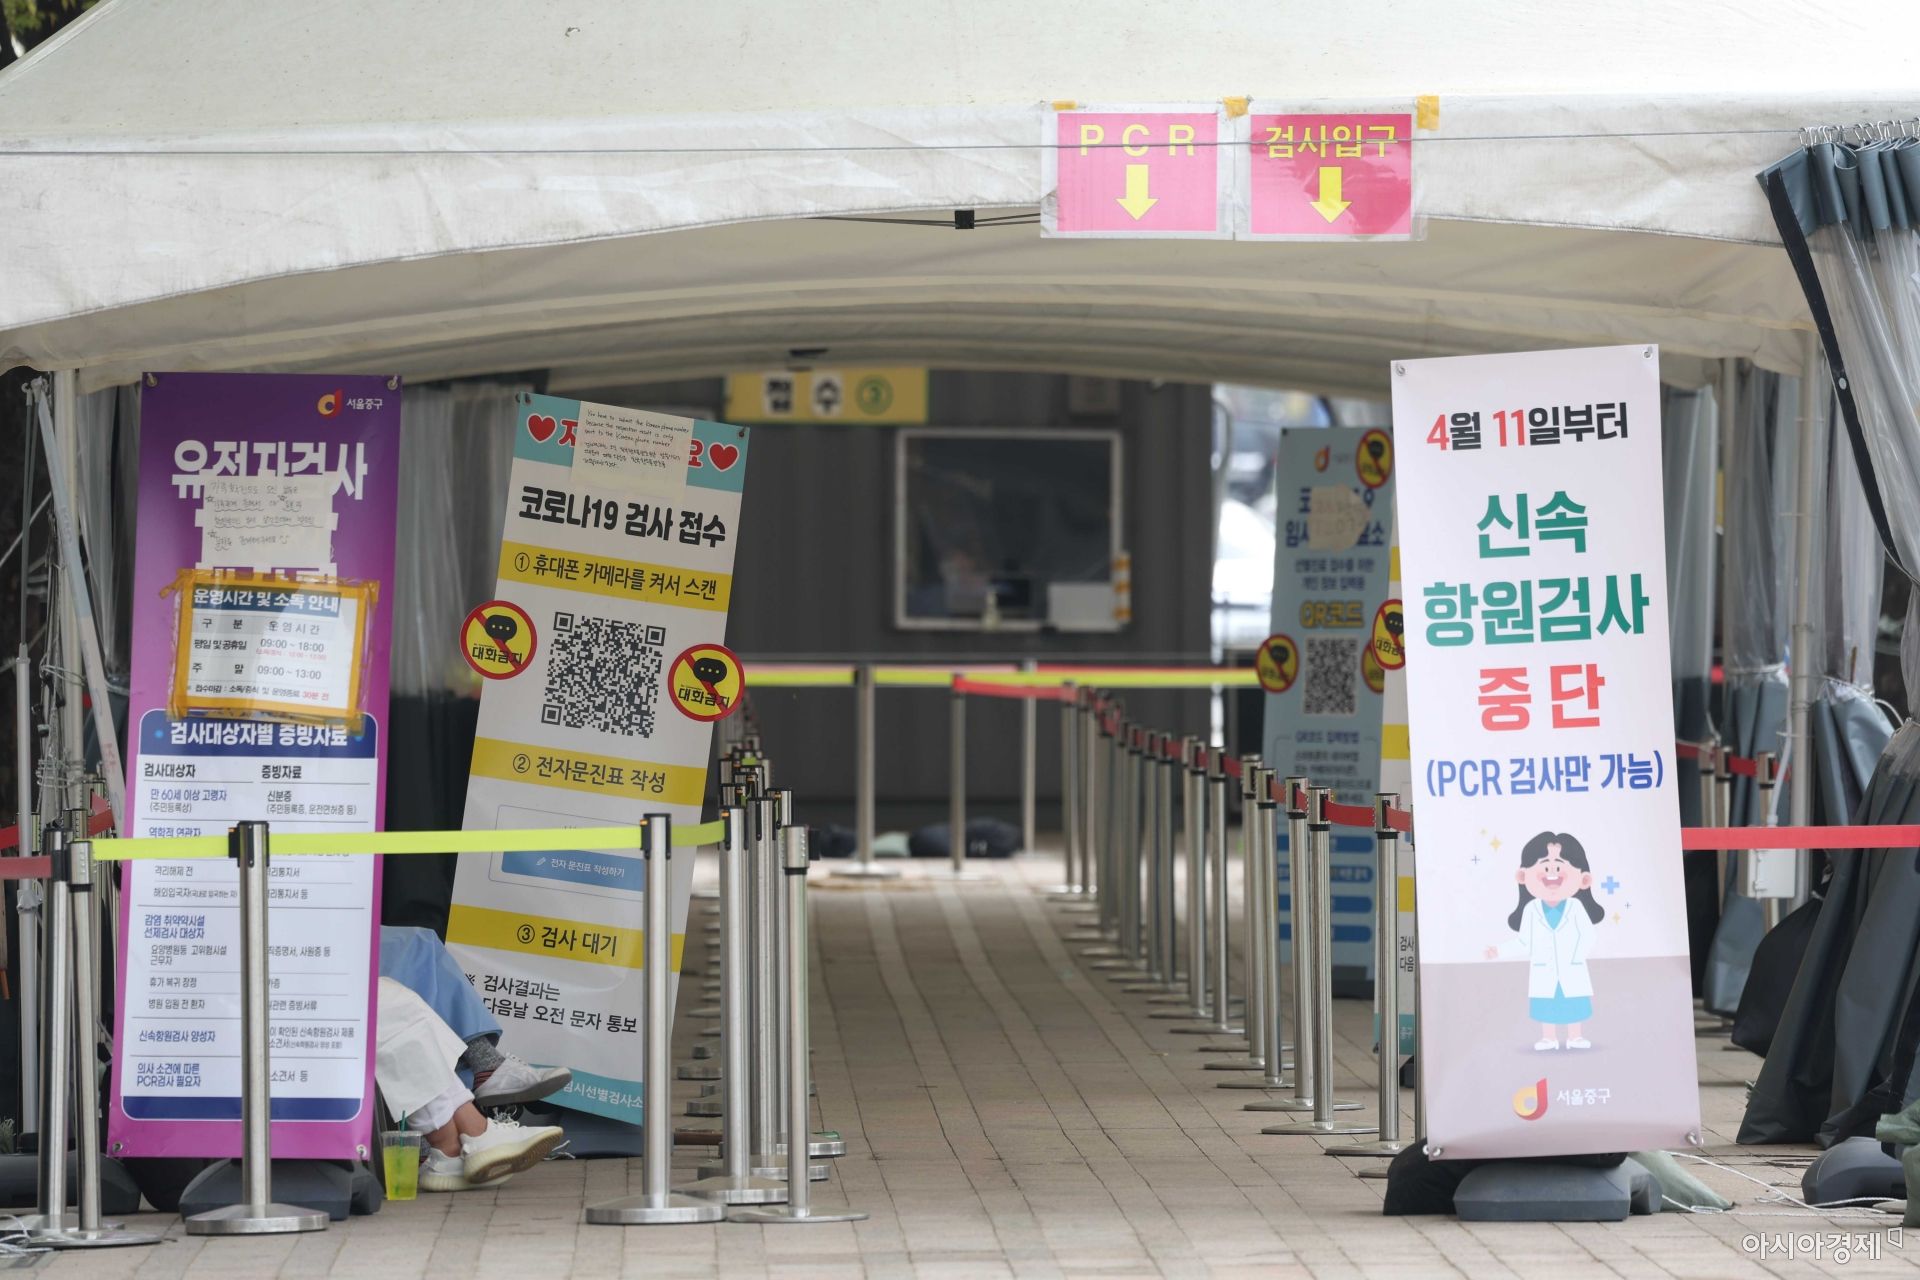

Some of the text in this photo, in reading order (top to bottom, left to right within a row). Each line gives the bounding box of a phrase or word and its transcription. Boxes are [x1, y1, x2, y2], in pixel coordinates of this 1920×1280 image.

[1079, 124, 1195, 157] PCR
[1264, 125, 1398, 159] 검사입구
[346, 398, 383, 410] 서울중구
[1426, 401, 1629, 451] 4월 11일부터
[518, 485, 726, 548] 코로나19 검사 접수
[1476, 490, 1589, 559] 신속
[533, 554, 580, 581] 휴대폰
[583, 562, 645, 591] 카메라를
[649, 572, 680, 597] 켜서
[683, 580, 717, 601] 스캔
[194, 588, 339, 613] 운영시간 및 소독 안내
[1423, 573, 1650, 647] 항원검사
[195, 640, 211, 649] 평일
[260, 638, 287, 648] 09:00
[299, 642, 324, 652] 18:00
[472, 646, 522, 665] 대화금지
[258, 665, 284, 676] 09:00
[295, 669, 321, 680] 13:00
[677, 687, 730, 709] 대화금지
[1478, 663, 1605, 732] 중단
[170, 722, 348, 746] 검사대상자별 증빙자료
[144, 763, 196, 778] 검사대상자
[261, 764, 302, 779] 증빙자료
[536, 756, 624, 787] 전자문진표
[630, 769, 666, 794] 작성
[1426, 750, 1664, 797] (PCR 검사만 가능)
[161, 789, 181, 800] 60세
[183, 789, 200, 801] 이상
[202, 789, 227, 801] 고령자
[267, 791, 292, 802] 신분증
[155, 866, 193, 876] 격리해제 전
[551, 858, 625, 878] 전자 문진표 작성하기
[145, 914, 161, 926] 감염
[144, 927, 204, 939] 선제검사 대상자
[541, 926, 577, 951] 검사
[582, 932, 617, 957] 대기
[150, 955, 172, 965] 근무자
[300, 946, 322, 957] 사원증
[323, 947, 331, 957] 등
[150, 977, 165, 987] 휴가
[166, 977, 181, 987] 복귀
[483, 974, 560, 1002] 검사결과는
[148, 999, 205, 1009] 병원 입원 전 환자
[482, 998, 637, 1033] 다음날 오전 문자 통보
[139, 1030, 216, 1042] 신속항원검사 양성자
[137, 1063, 200, 1075] 의사 소견에 따른
[271, 1070, 308, 1082] 소견서 등
[137, 1075, 201, 1088] PCR검사 필요자
[1556, 1087, 1612, 1106] 서울중구
